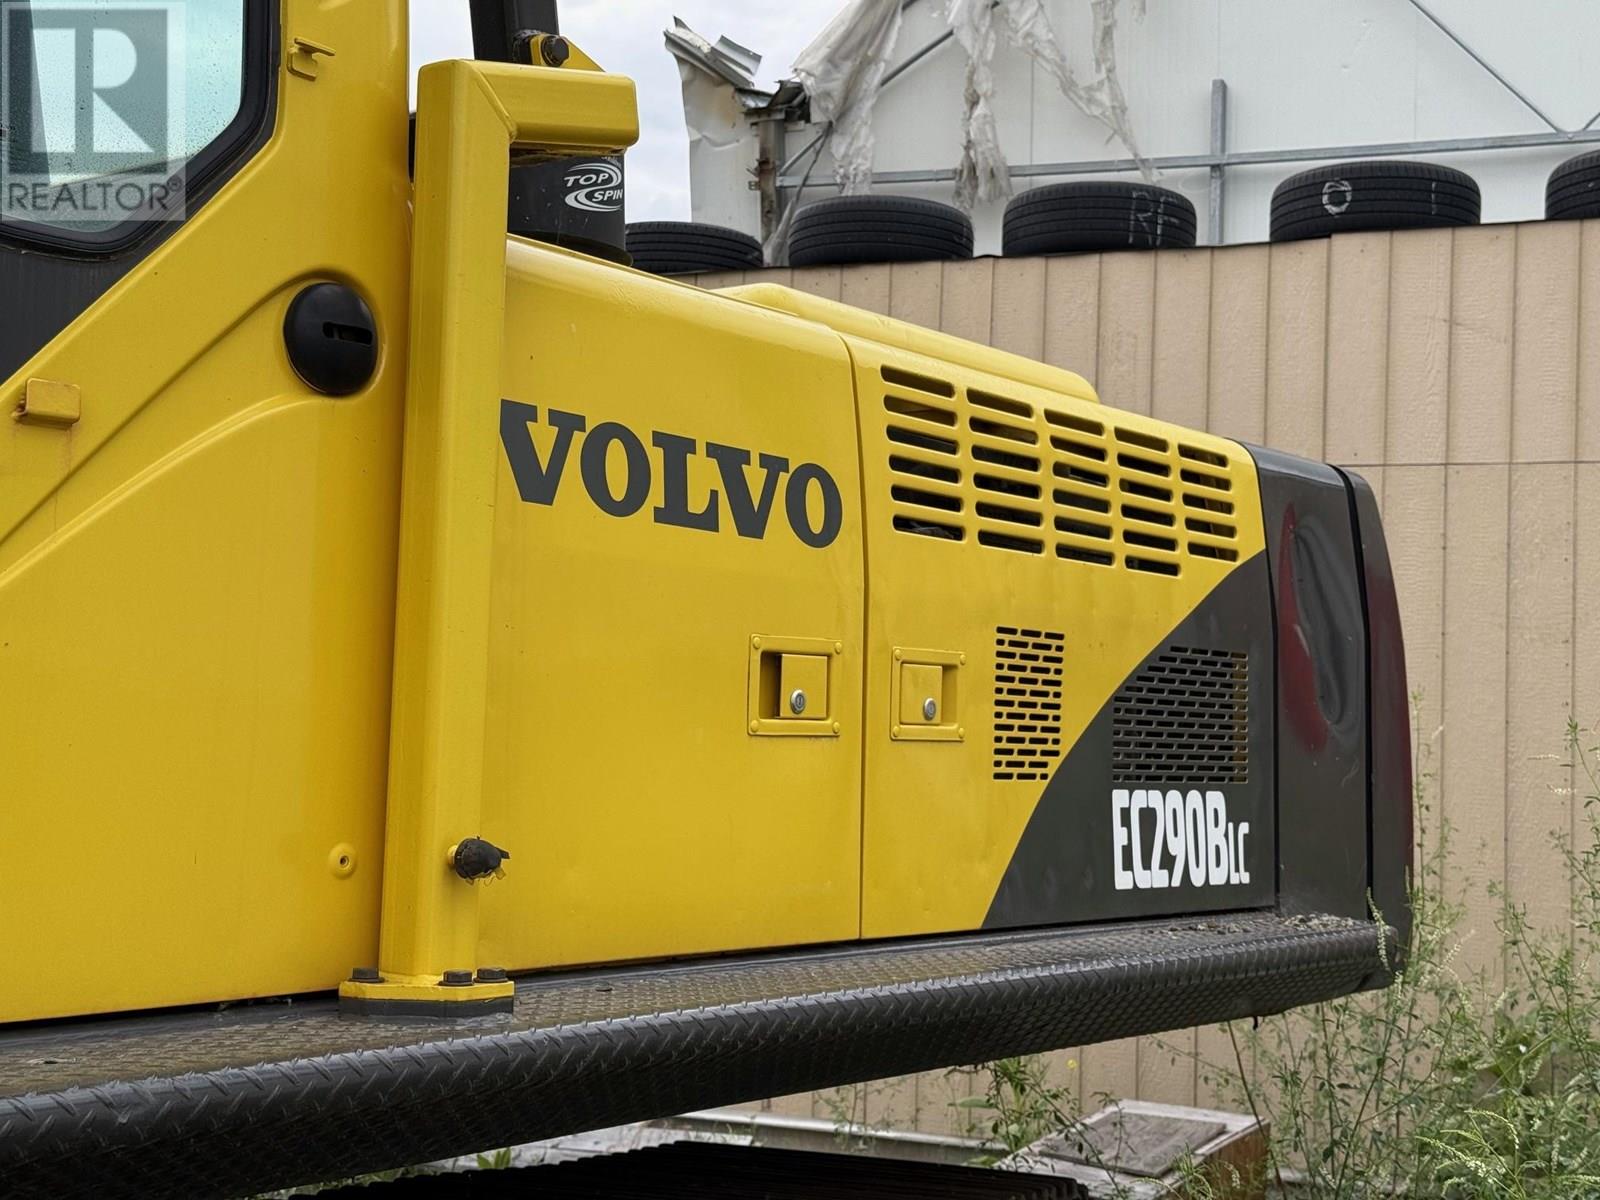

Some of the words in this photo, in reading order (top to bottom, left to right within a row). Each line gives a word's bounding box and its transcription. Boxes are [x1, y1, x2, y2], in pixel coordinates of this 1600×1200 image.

[563, 173, 609, 187] TOP
[591, 189, 623, 202] SPIN
[499, 398, 843, 549] VOLVO
